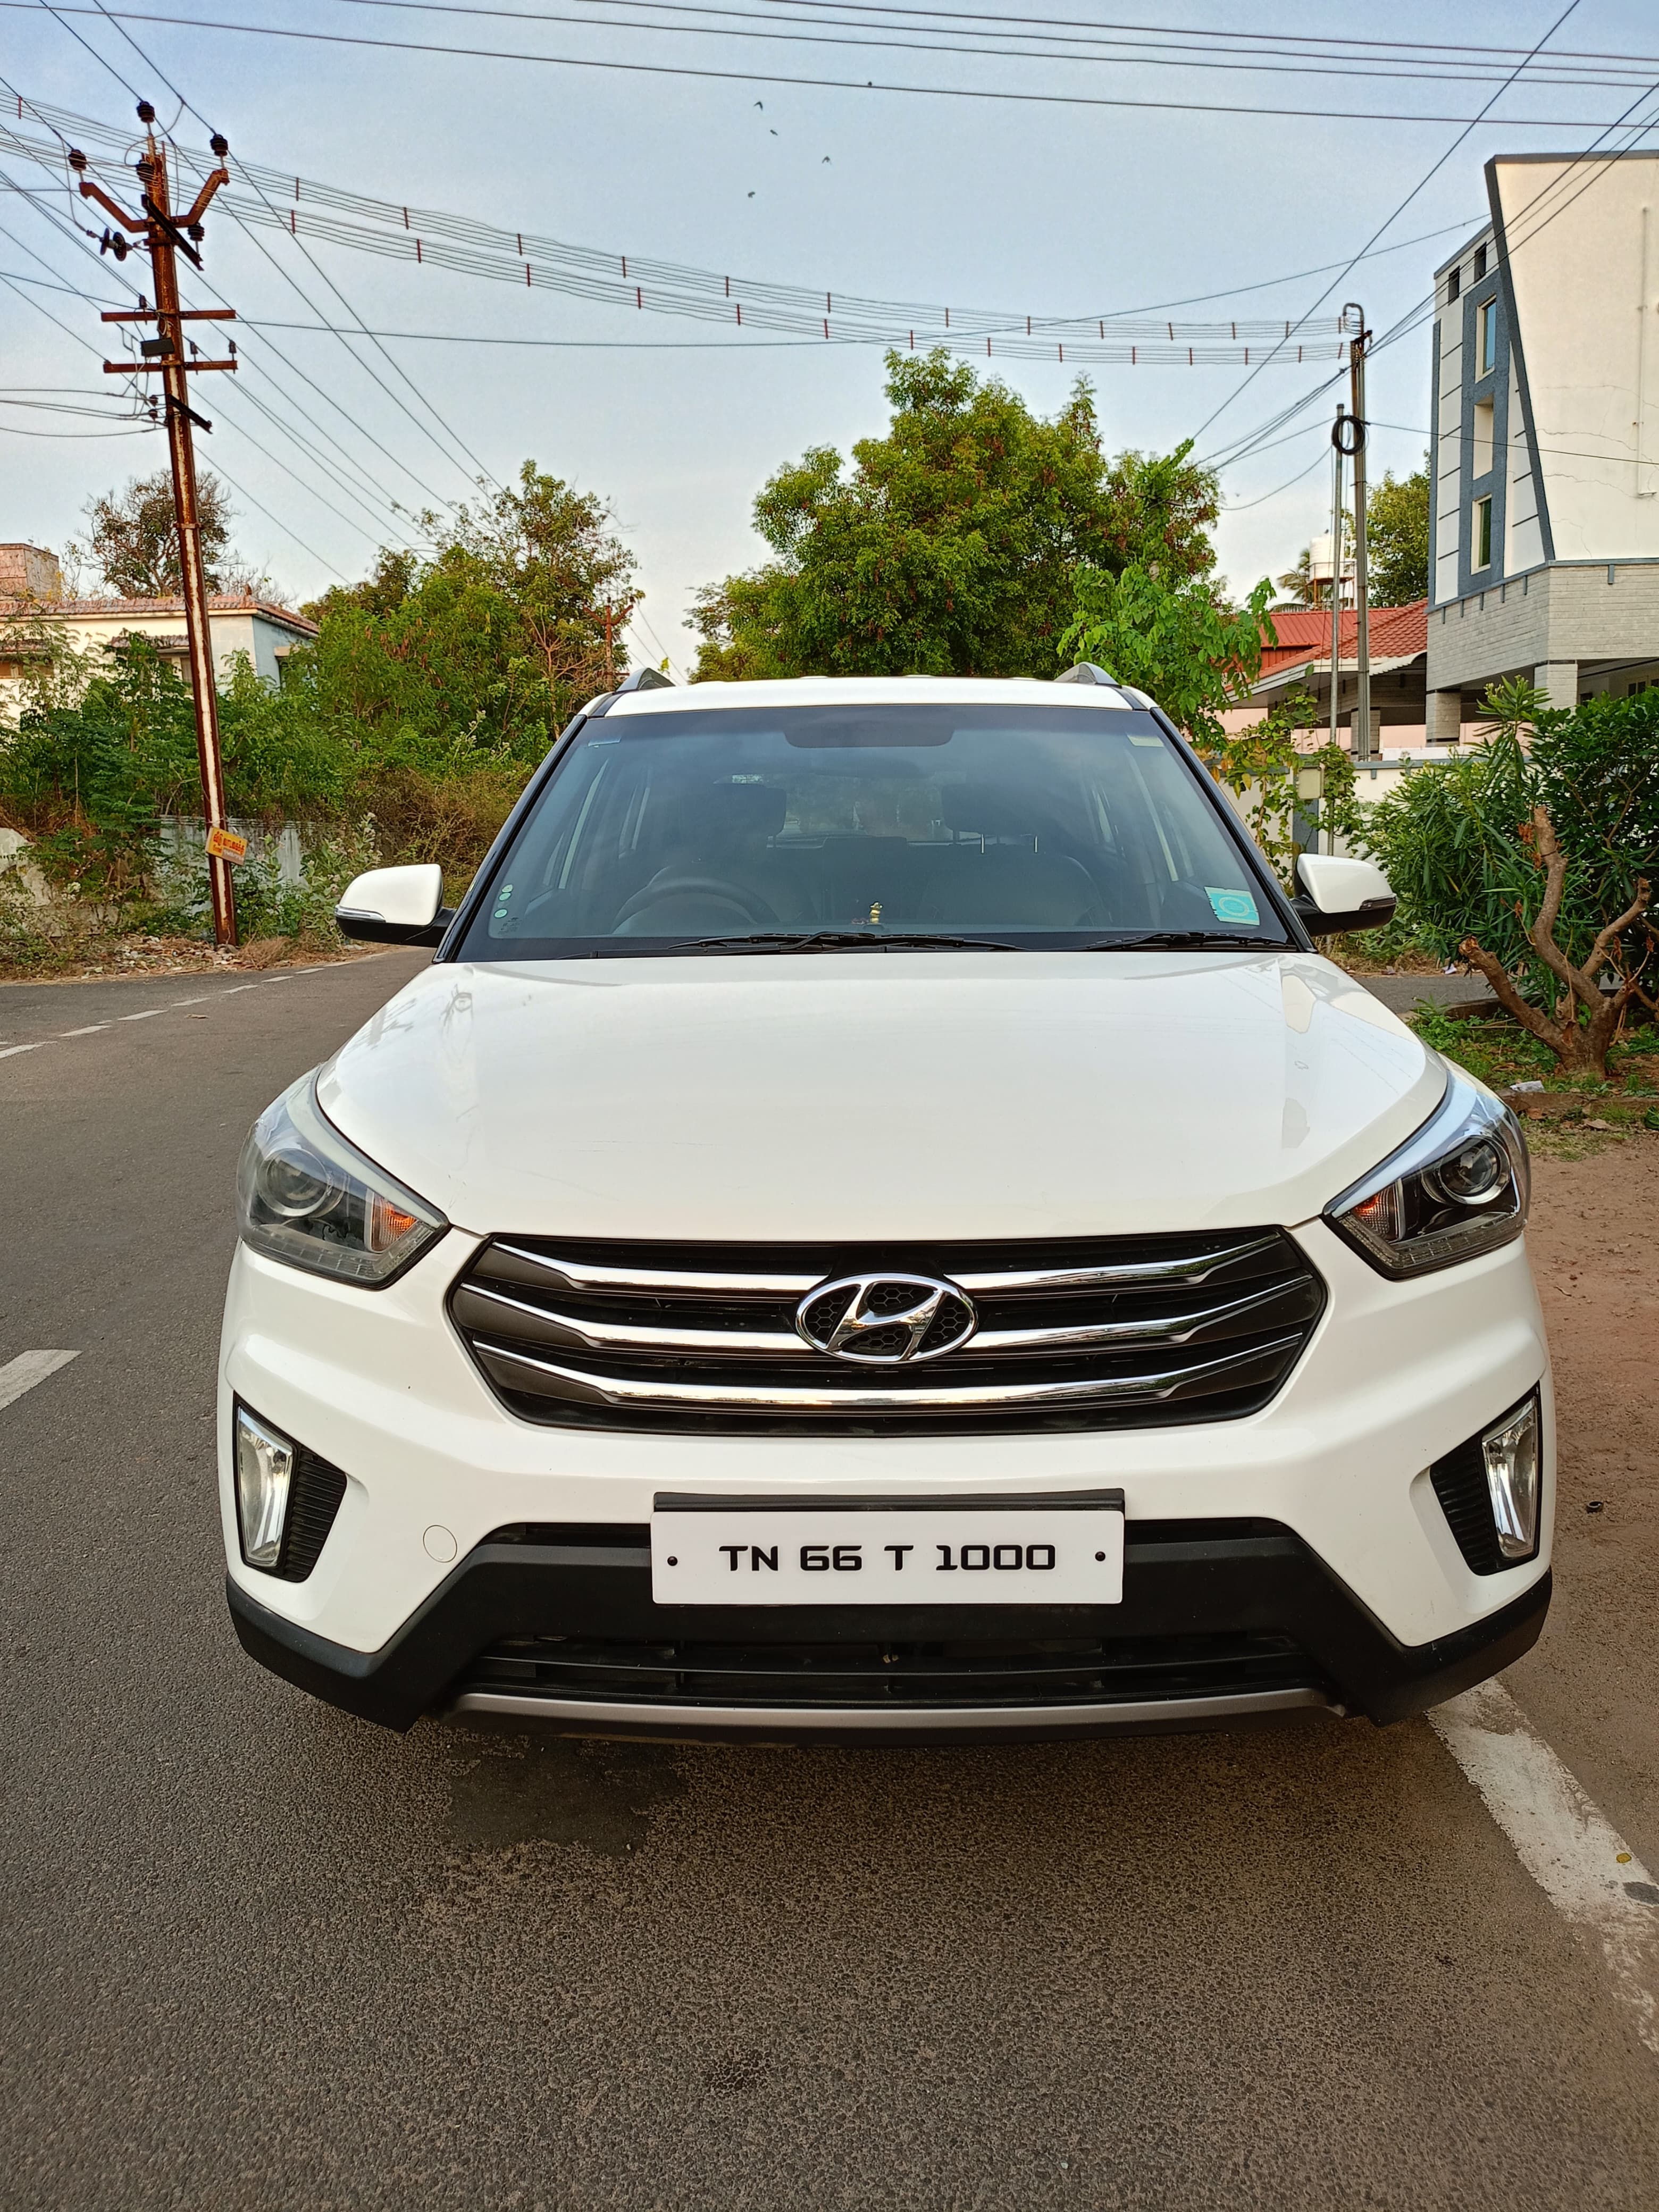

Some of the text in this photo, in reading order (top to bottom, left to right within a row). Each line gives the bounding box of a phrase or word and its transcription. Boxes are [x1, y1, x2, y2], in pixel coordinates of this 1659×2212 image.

[718, 1544, 1055, 1571] TN 66 T 1000
